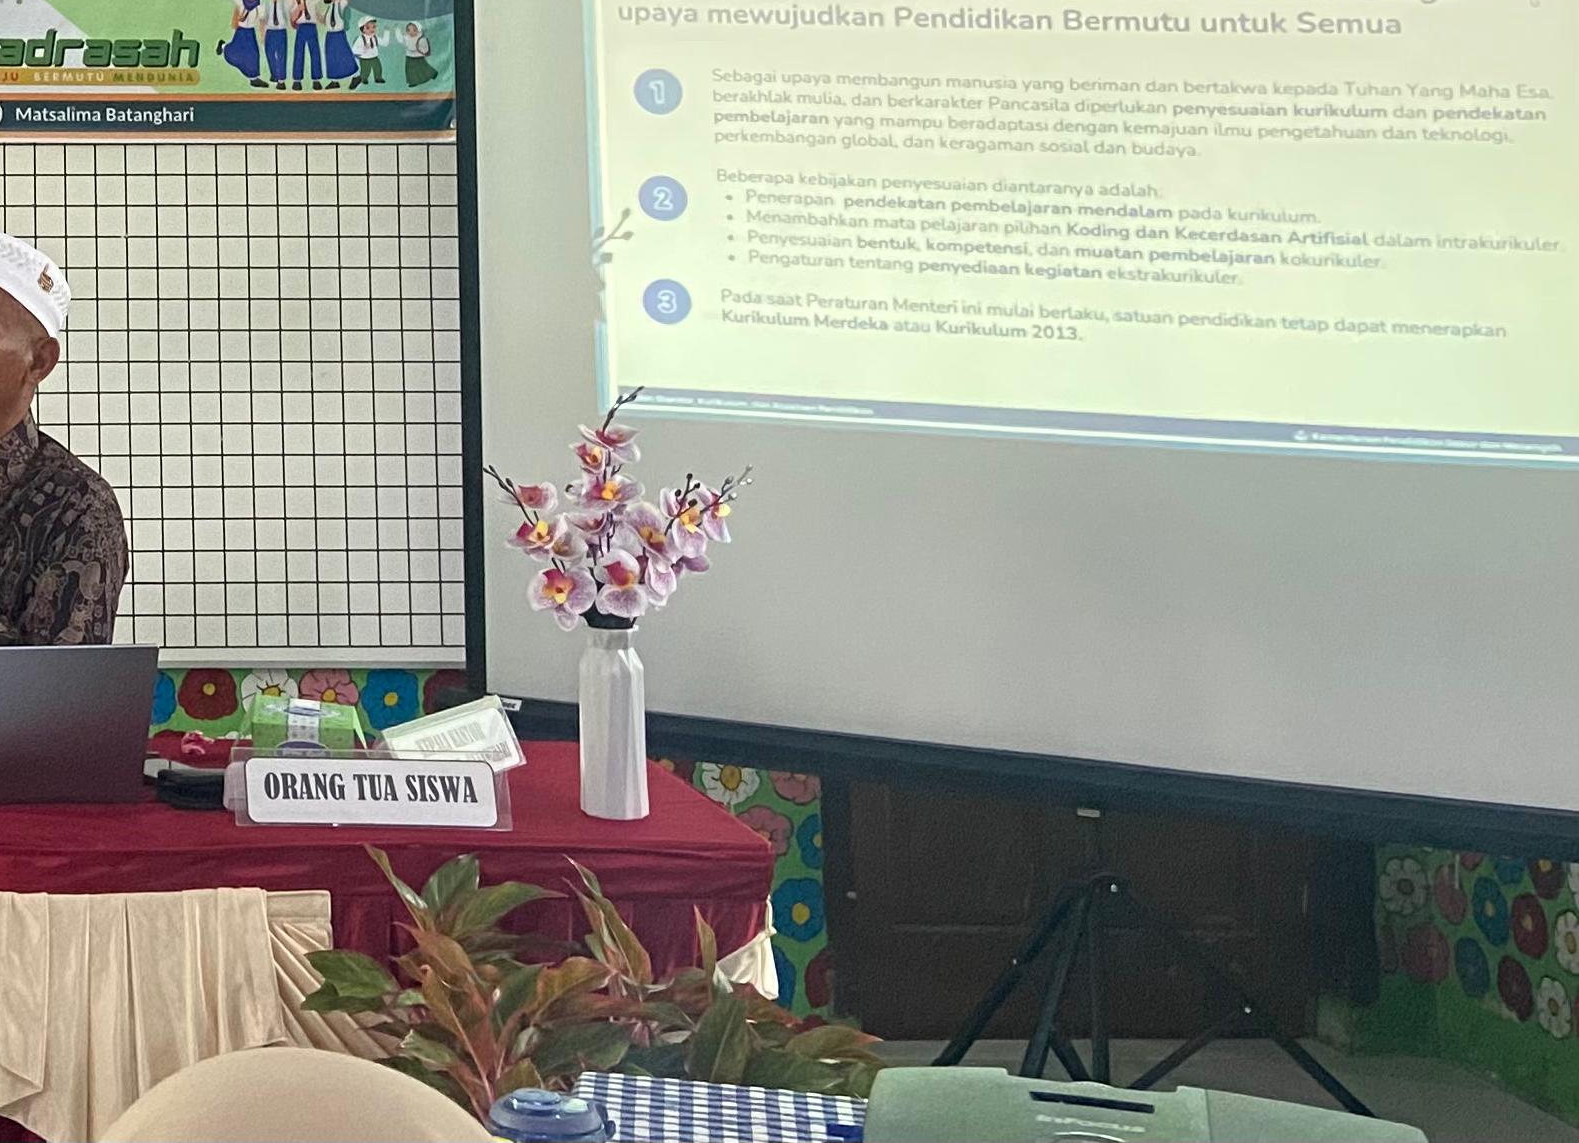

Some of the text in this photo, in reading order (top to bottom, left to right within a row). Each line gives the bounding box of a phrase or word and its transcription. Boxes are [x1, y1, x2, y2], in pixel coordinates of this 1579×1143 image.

[618, 3, 1402, 35] upaya mewujudkan Pendidikan Bermutu untuk Semua
[33, 71, 105, 83] BERMUTU
[112, 71, 194, 83] MENDUNIA
[712, 68, 1339, 98] Sebagai upaya membangun yang dan bertakwa kepada
[15, 106, 195, 126] Matsalima Batanghari
[712, 88, 1547, 123] berakhlak dan berkarakter Pancasila diperlukan penyesuaian kurikulum dan pendekatan
[714, 109, 1417, 142] pembelajaran yang mampu beradaptasi kemajuan pengetahuan dan
[714, 128, 1127, 155] perkembangan dan keragaman sosial dan
[716, 168, 988, 194] Beberapa kebijakan penyesuaian
[652, 186, 674, 211] 2
[745, 188, 1174, 220] Penerapan pendekatan pembelajaran mendalam
[746, 209, 1370, 247] Menambahkan mata pelajaran Koding dan Kecerdasan Artifisial
[747, 229, 1277, 267] Penyesuaian pembelajaran
[748, 249, 1020, 279] Pengaturan tentang penyediaan
[656, 289, 678, 315] 3
[720, 288, 1507, 339] Pada saat Peraturan pendidikan menerapkan
[721, 308, 1028, 339] Kurikulum Merdeka Kurikulum
[263, 772, 479, 804] ORANG TUA SISWA
